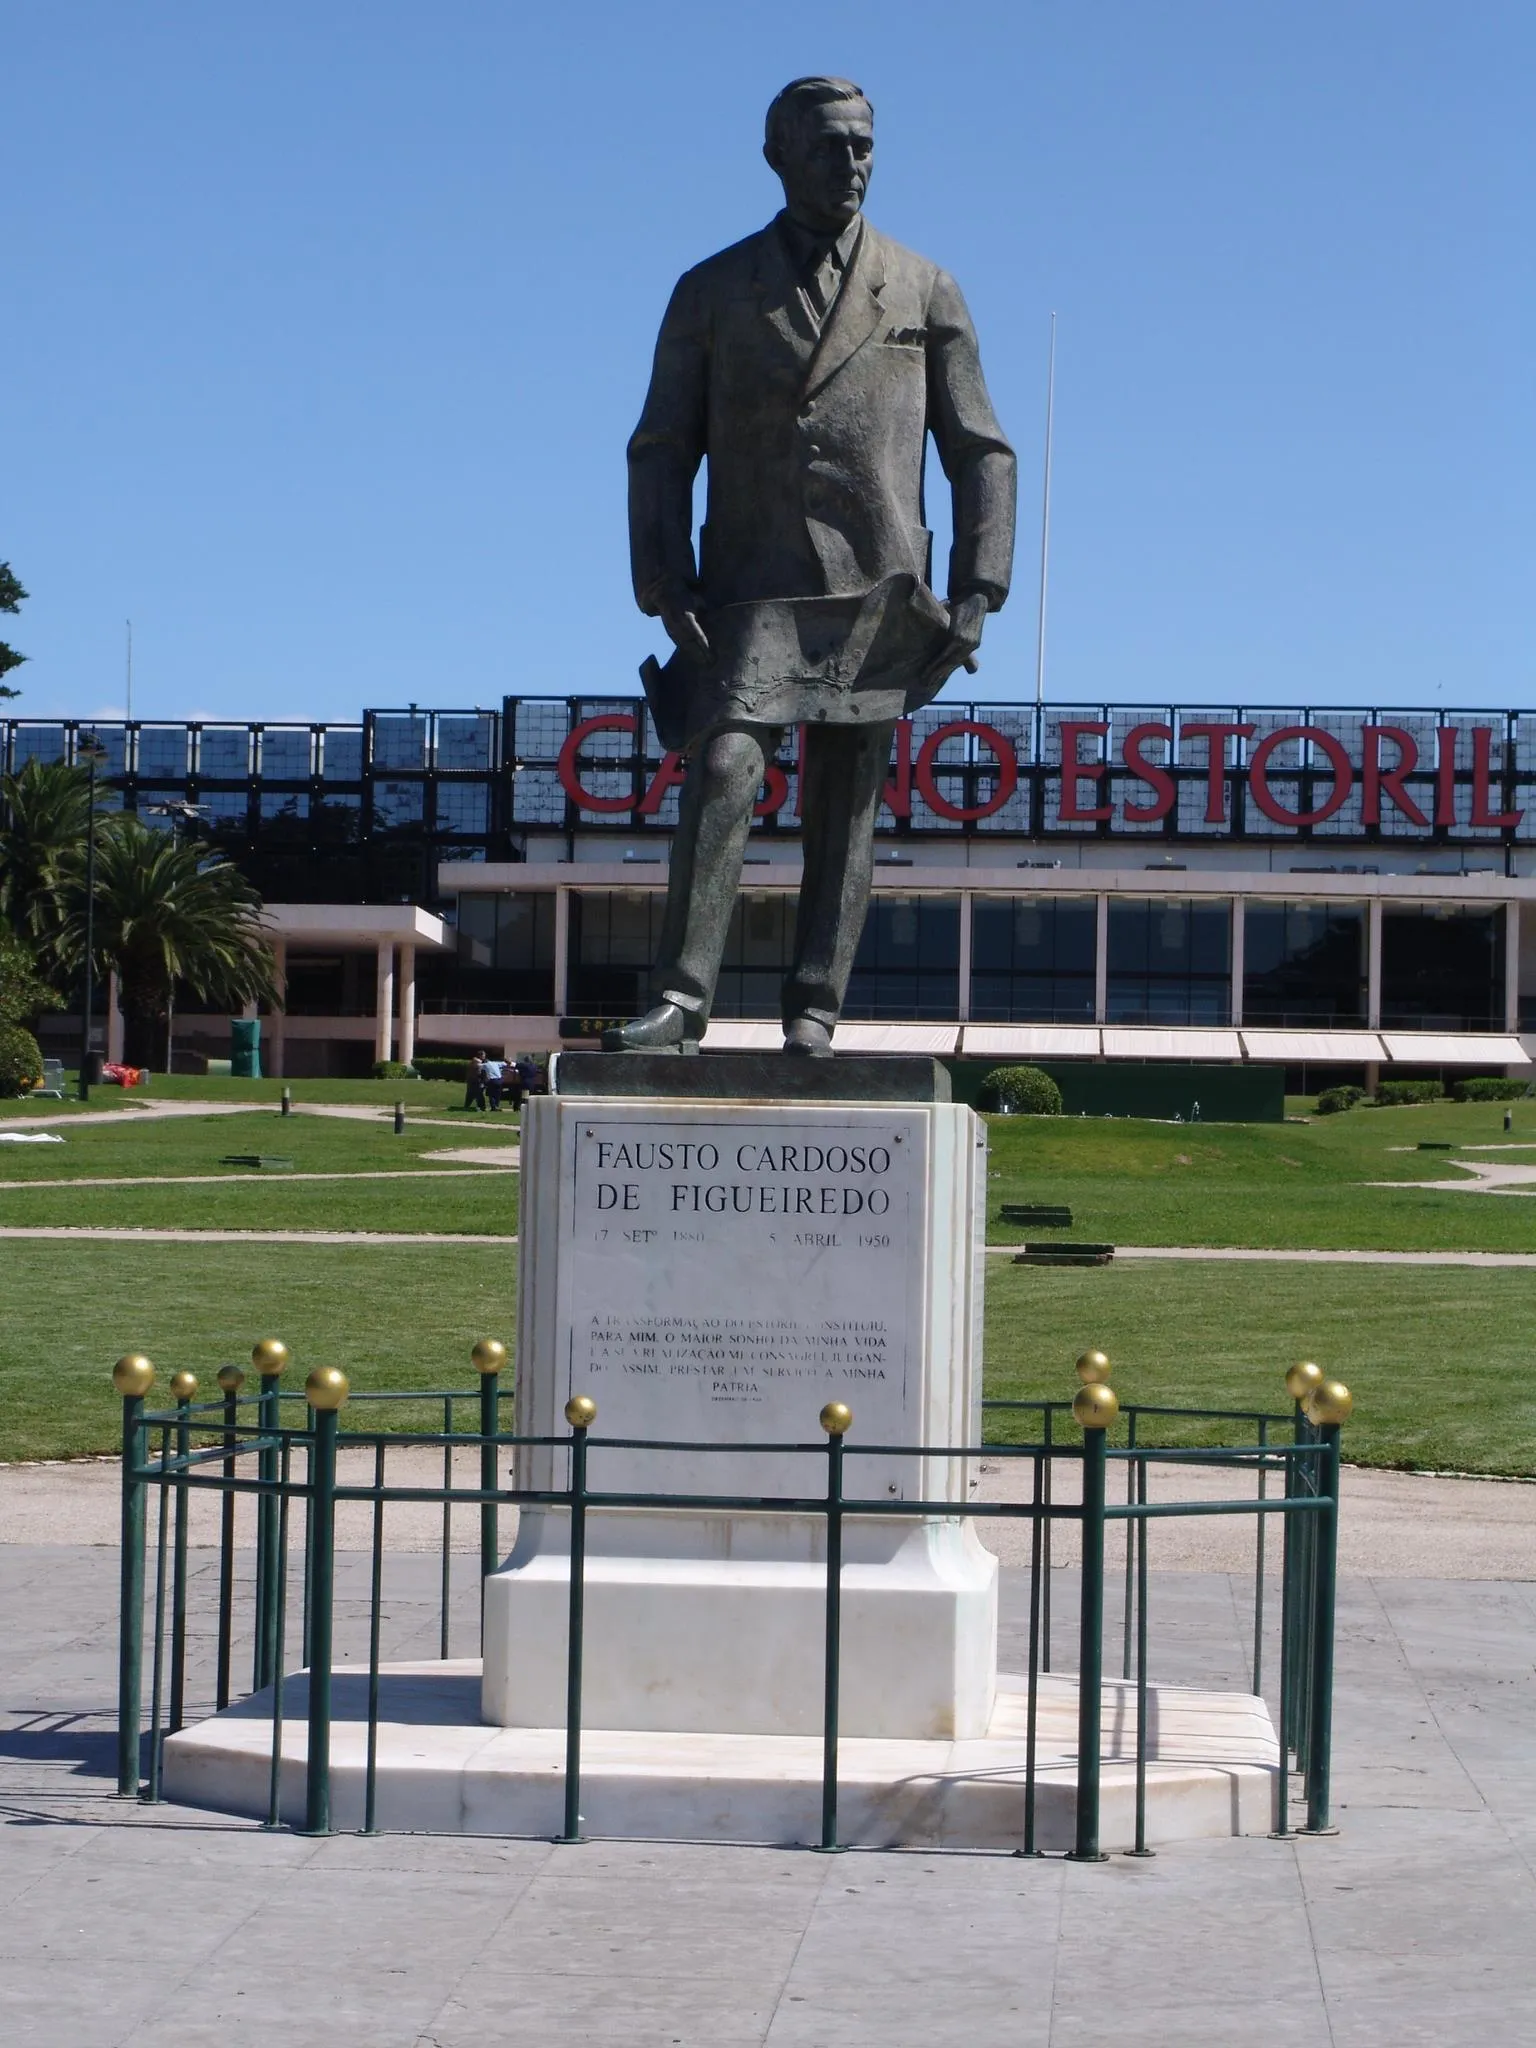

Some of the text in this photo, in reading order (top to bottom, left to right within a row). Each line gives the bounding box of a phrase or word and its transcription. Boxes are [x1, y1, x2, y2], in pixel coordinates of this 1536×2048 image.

[1056, 721, 1525, 827] ESTORIL
[596, 1142, 891, 1174] FAUSTO CARDOSO
[596, 1184, 890, 1215] DE FIGUEIREDO
[794, 1233, 842, 1247] ABRIL
[859, 1234, 890, 1247] 1950
[591, 1315, 600, 1326] A
[591, 1331, 623, 1342] PARA
[665, 1332, 675, 1343] O
[681, 1333, 722, 1344] MAIOR
[729, 1335, 774, 1345] SONHO
[805, 1336, 848, 1347] MINHA
[855, 1337, 887, 1348] VIDA
[842, 1369, 886, 1380] MINHA
